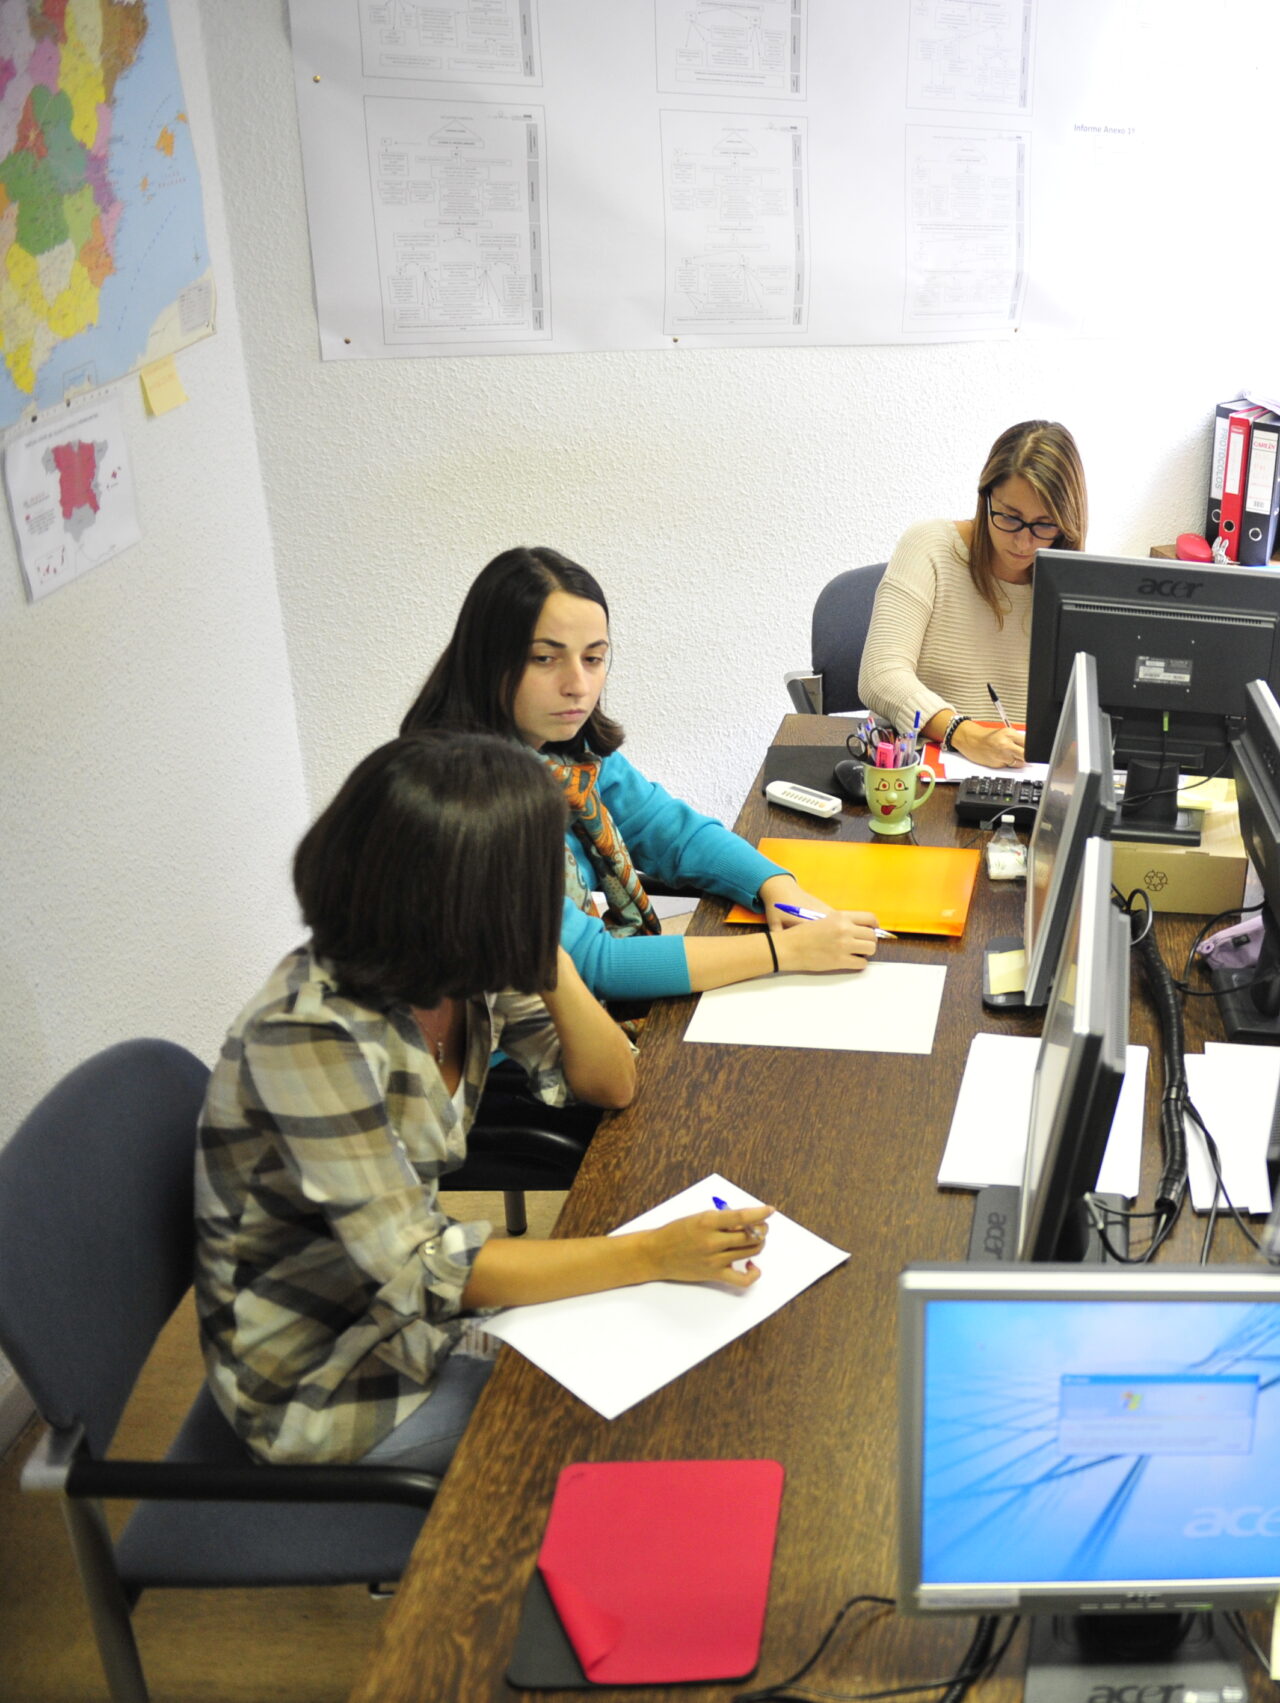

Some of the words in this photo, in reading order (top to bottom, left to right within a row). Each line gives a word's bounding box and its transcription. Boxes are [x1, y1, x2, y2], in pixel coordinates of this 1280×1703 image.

[1074, 124, 1102, 134] Informe
[1138, 578, 1203, 599] acer
[983, 1211, 1007, 1260] acer
[1088, 1682, 1185, 1703] acer
